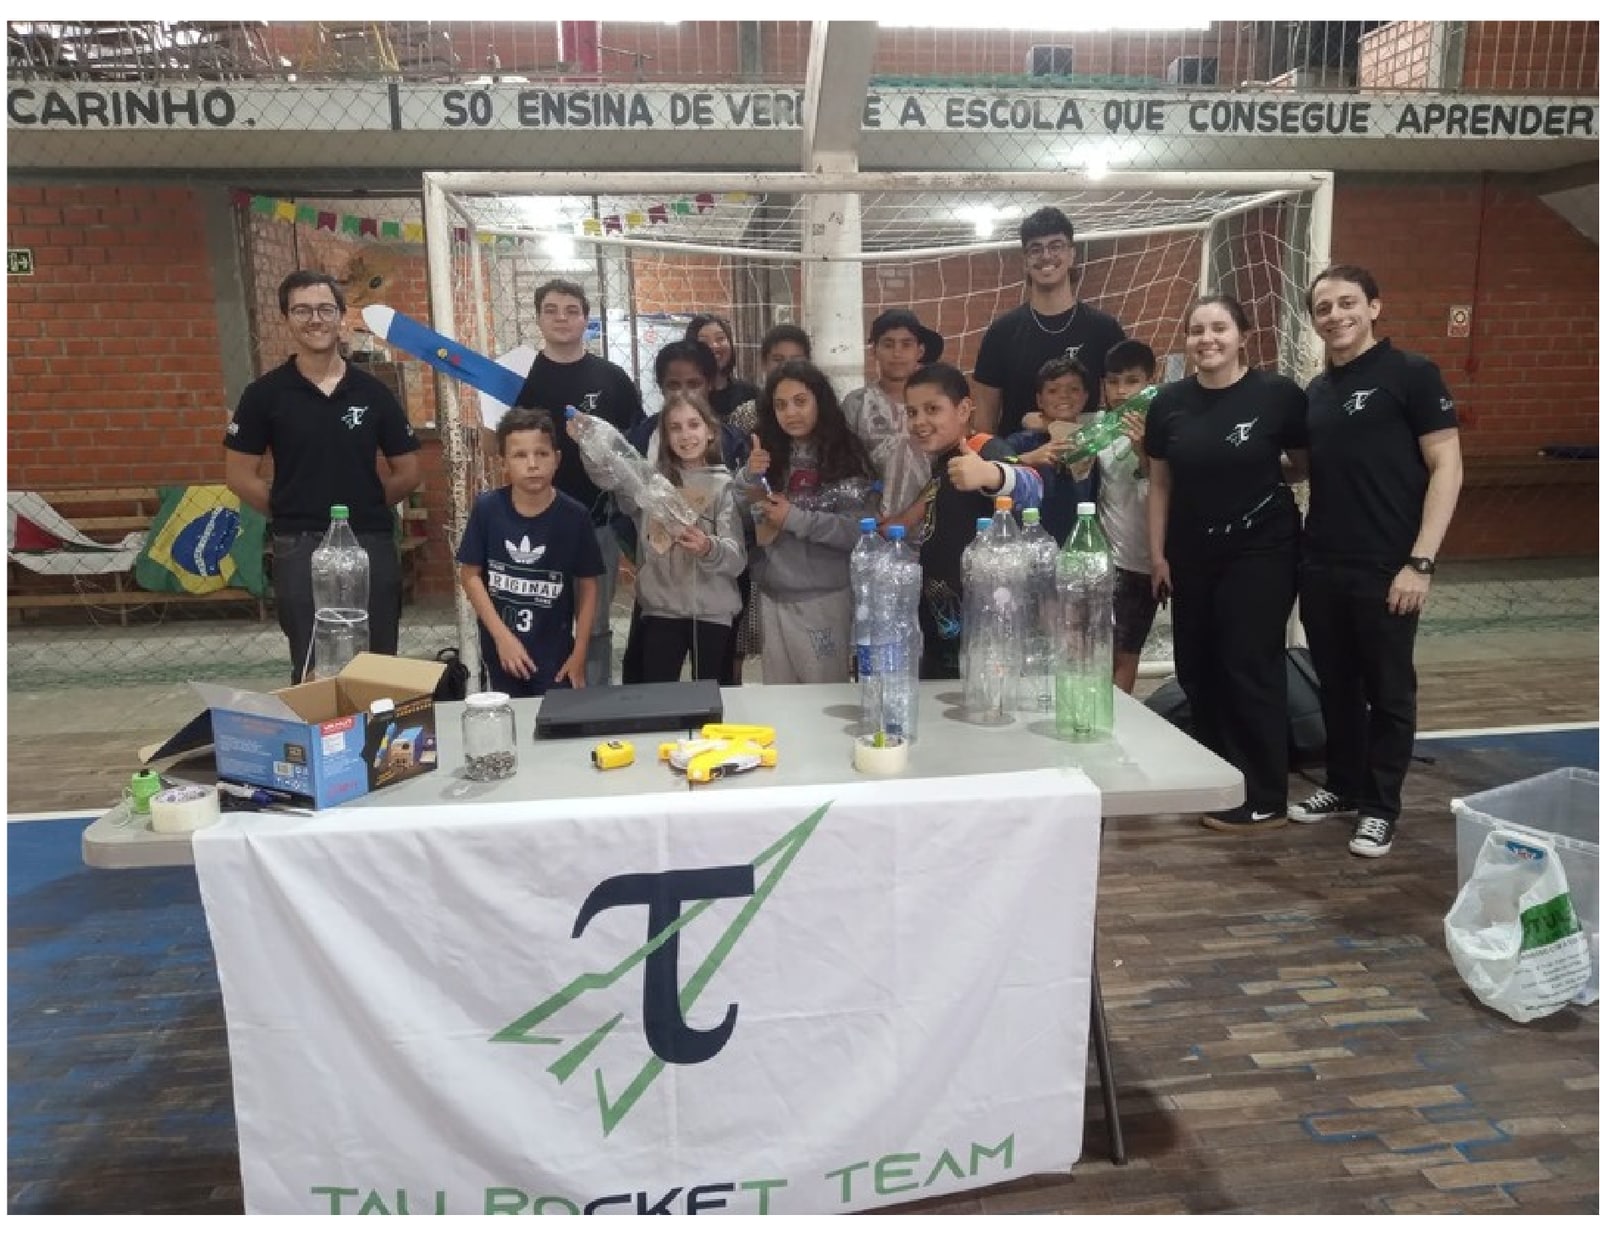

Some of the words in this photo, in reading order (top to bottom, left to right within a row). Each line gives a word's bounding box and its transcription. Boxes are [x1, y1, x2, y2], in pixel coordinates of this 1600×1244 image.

[443, 84, 494, 127] SÓ
[517, 90, 654, 127] ENSINA
[669, 92, 714, 127] DE
[900, 96, 927, 128] A
[946, 97, 1083, 131] ESCOLA
[1103, 99, 1165, 134] QUE
[1188, 99, 1372, 134] CONSEGUE
[489, 572, 561, 598] RIGINAL
[311, 1186, 446, 1216] TAU
[484, 1179, 788, 1216] ROCKET
[824, 1132, 1015, 1204] TEAM
